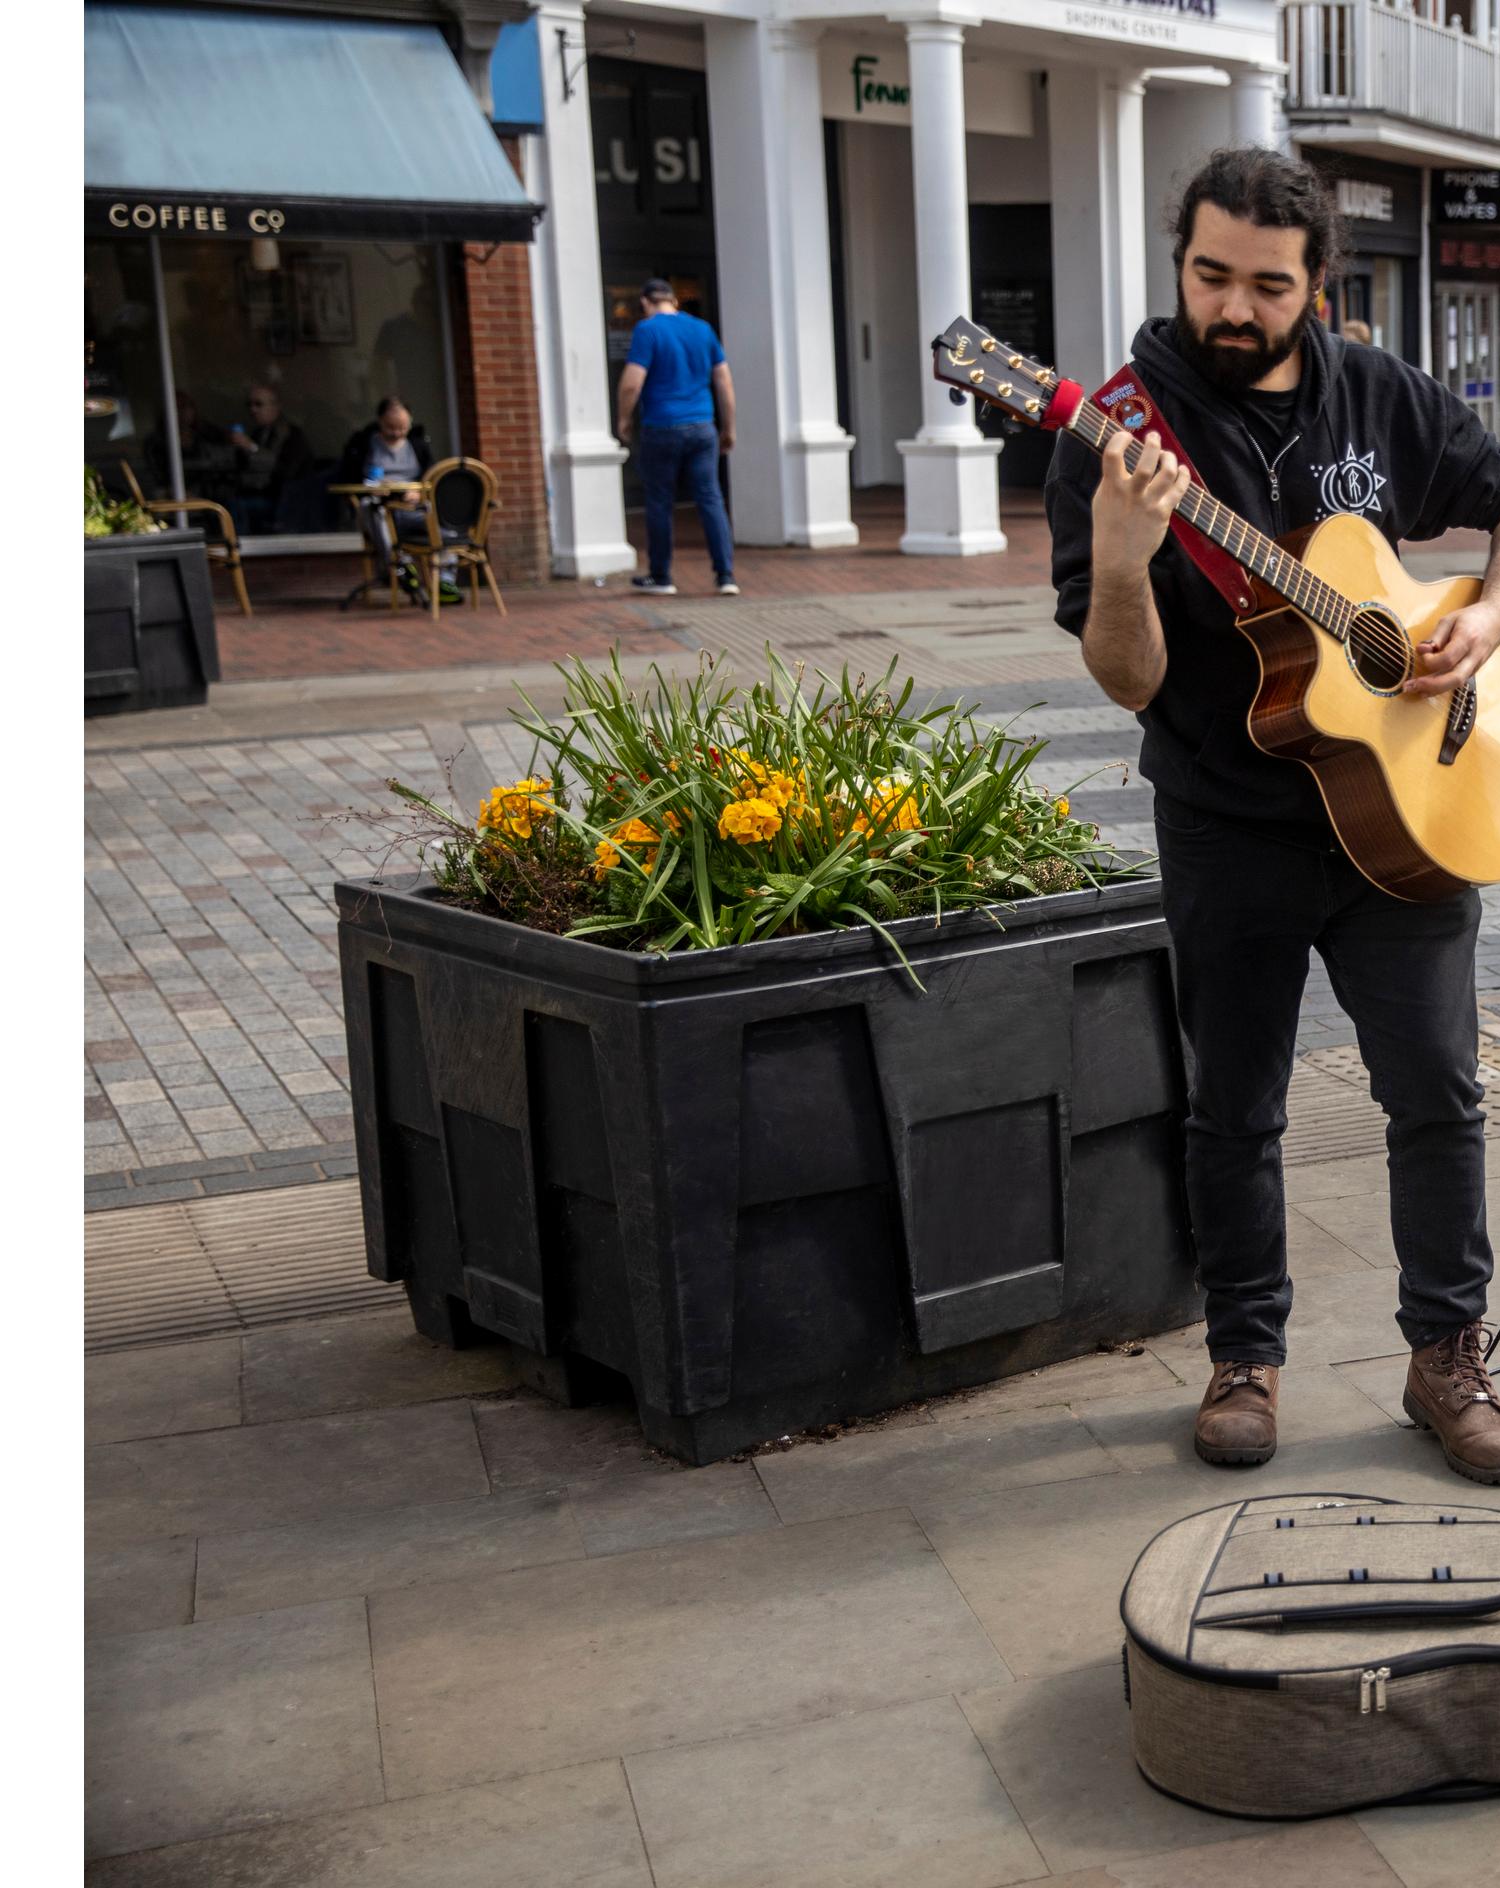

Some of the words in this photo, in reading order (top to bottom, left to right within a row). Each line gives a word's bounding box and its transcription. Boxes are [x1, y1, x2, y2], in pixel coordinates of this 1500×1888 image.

[1065, 8, 1128, 34] SHOPPING
[1133, 20, 1177, 42] CENTRE
[1444, 171, 1500, 189] PHONE
[1464, 187, 1478, 204] &
[109, 203, 228, 231] COFFEE
[1444, 202, 1498, 220] VAPES
